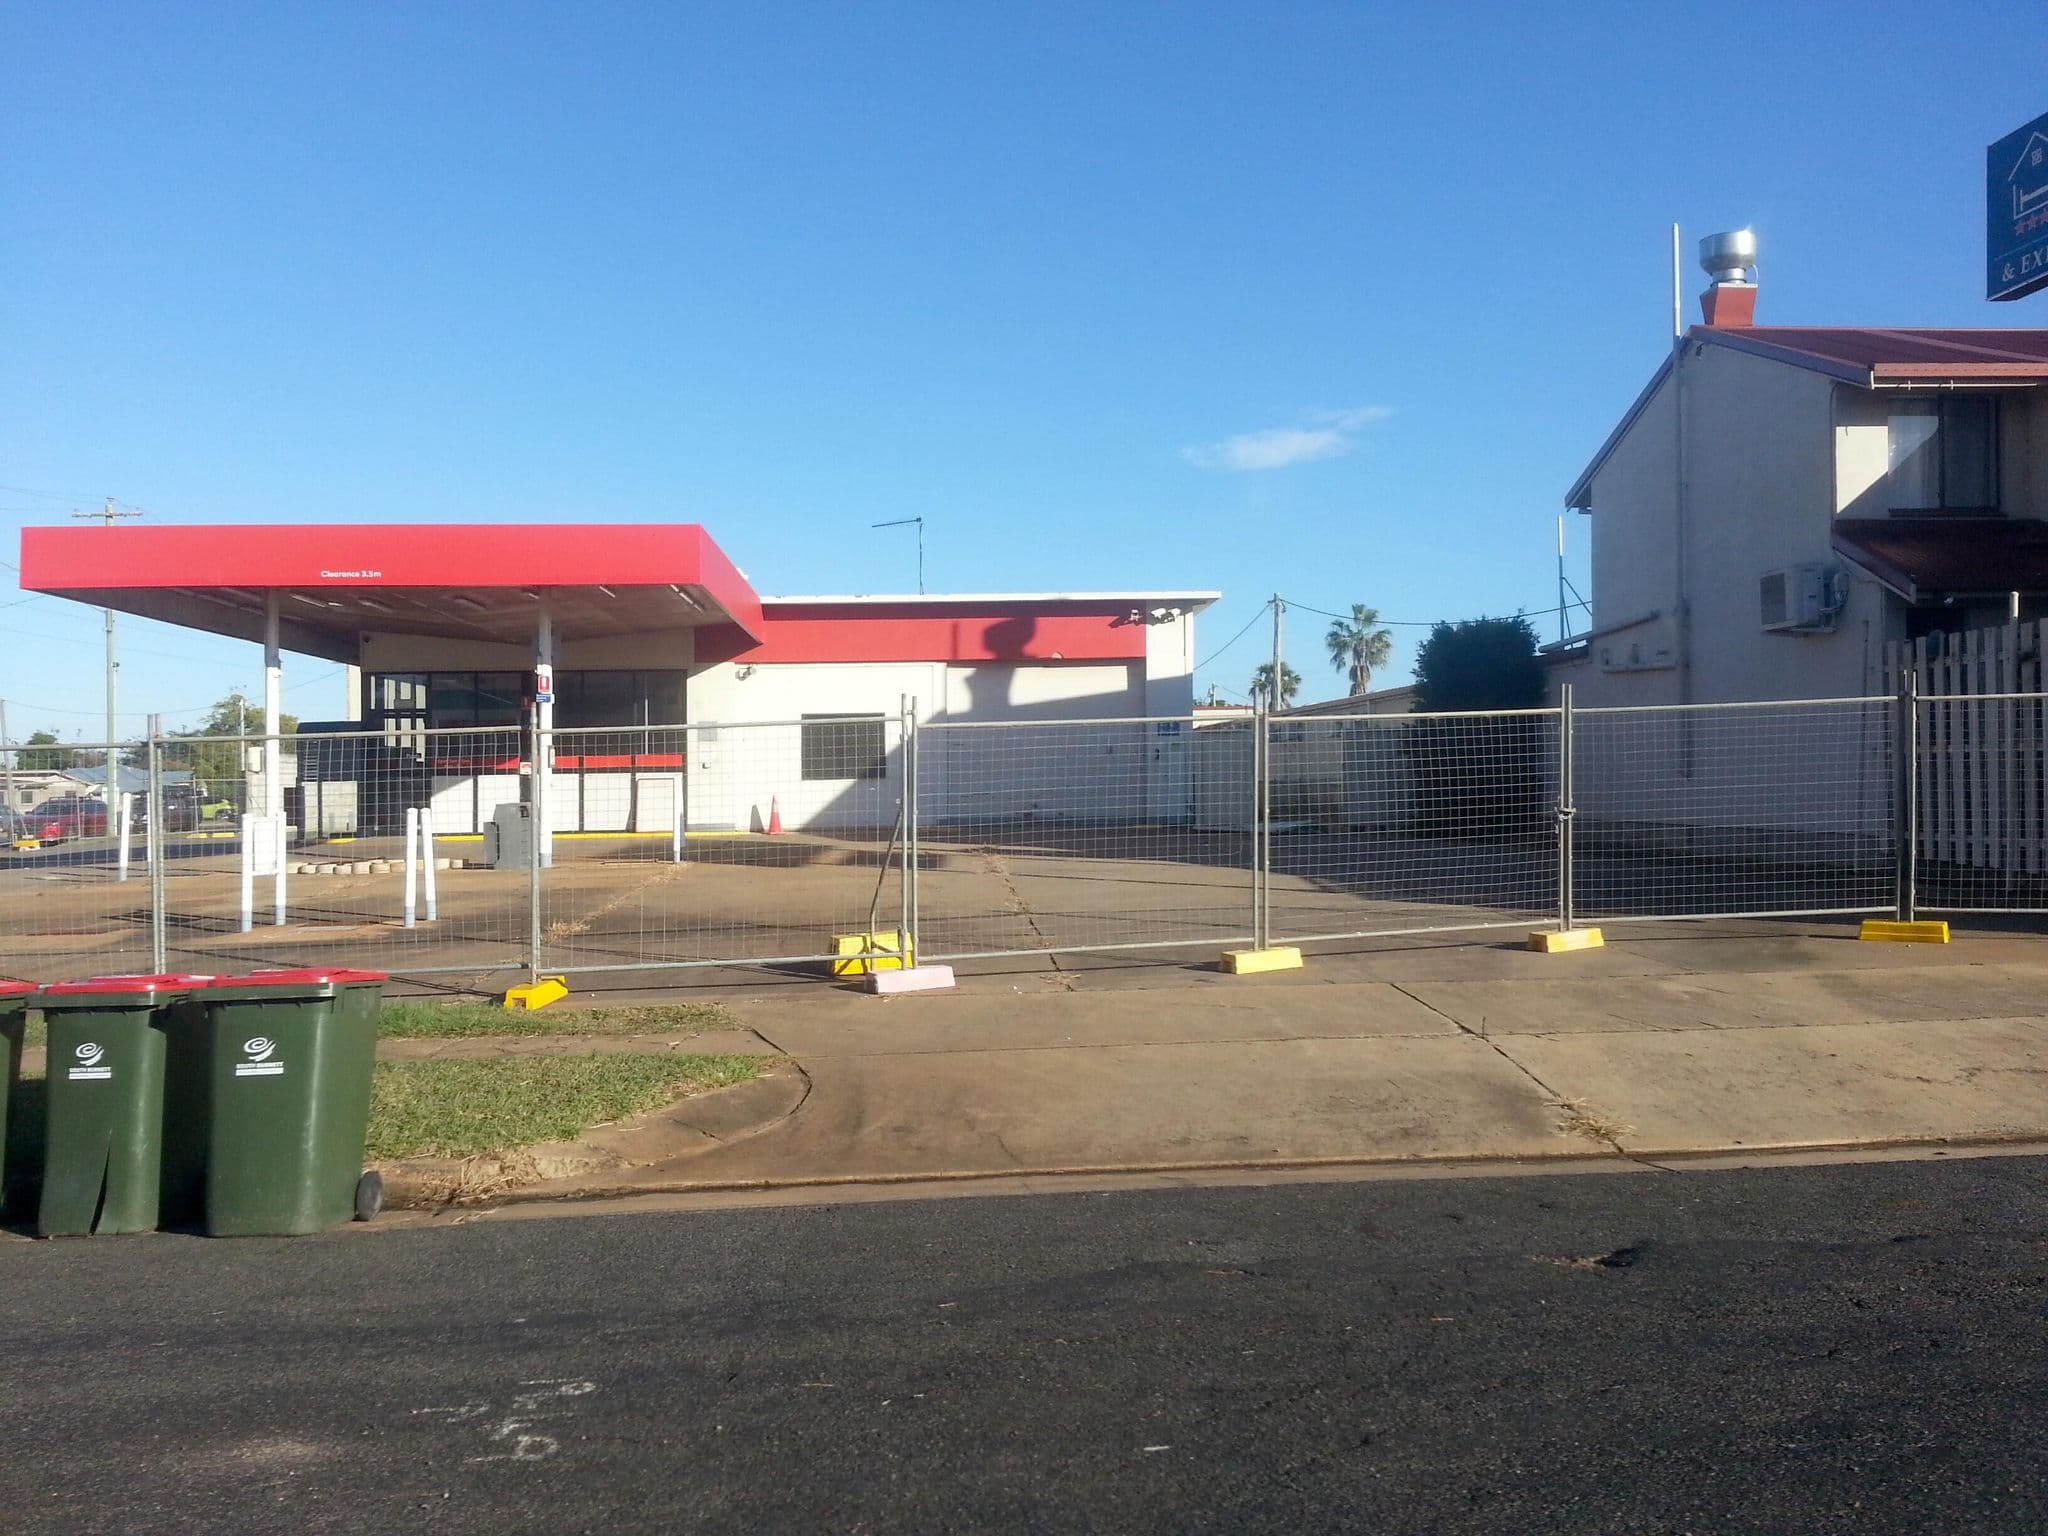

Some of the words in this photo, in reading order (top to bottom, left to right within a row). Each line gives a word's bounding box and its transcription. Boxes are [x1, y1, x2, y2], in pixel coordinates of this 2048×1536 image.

[2002, 263, 2016, 282] &
[2019, 246, 2048, 275] EX
[320, 570, 360, 578] Clearance
[361, 570, 382, 578] 3.5m
